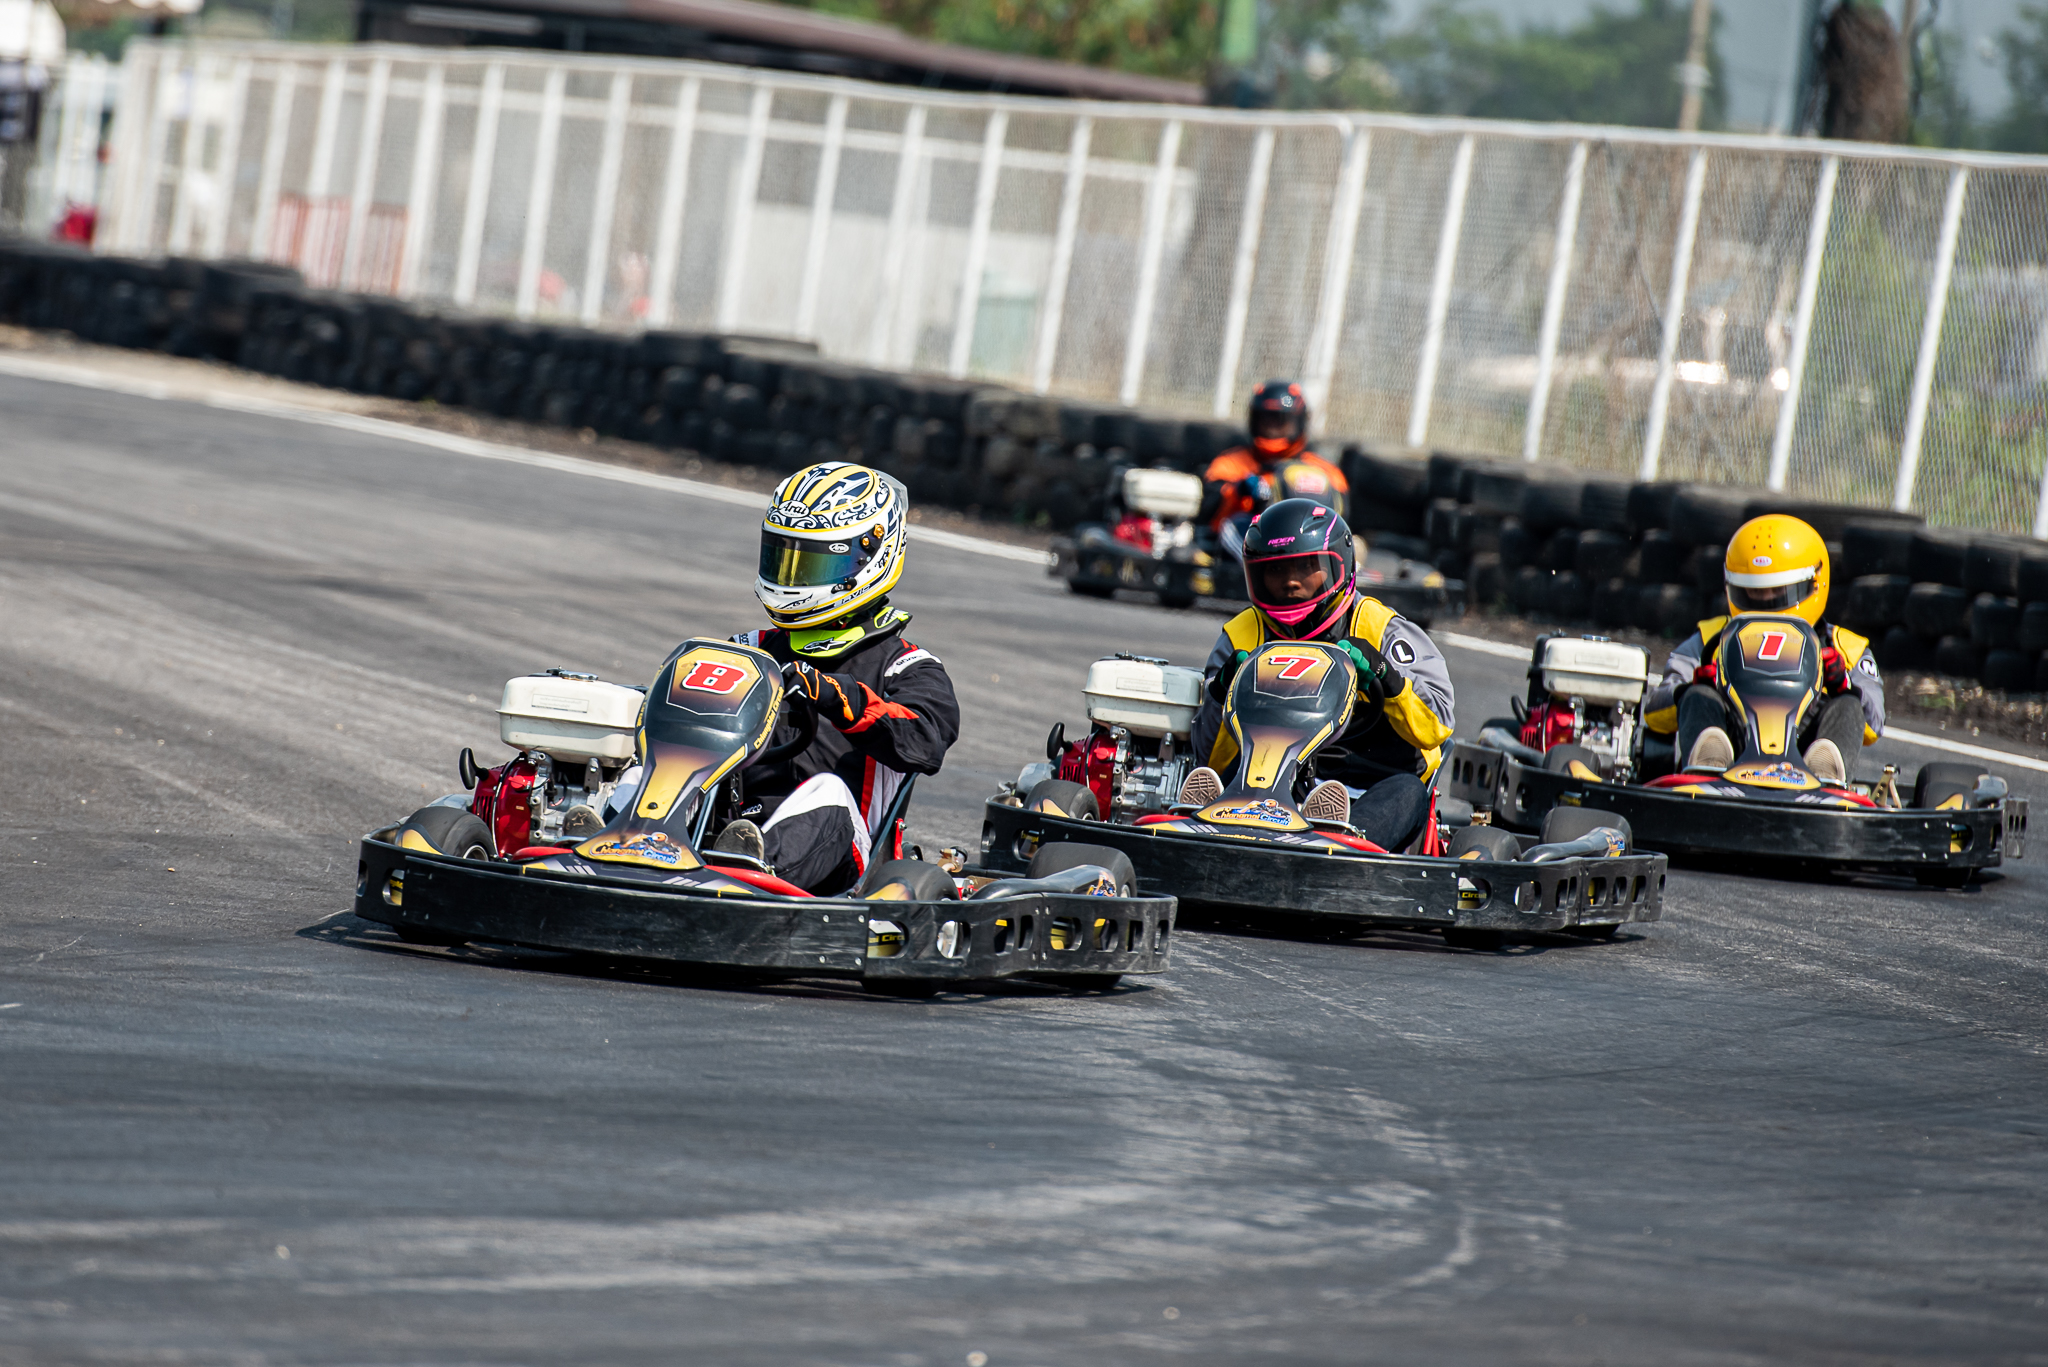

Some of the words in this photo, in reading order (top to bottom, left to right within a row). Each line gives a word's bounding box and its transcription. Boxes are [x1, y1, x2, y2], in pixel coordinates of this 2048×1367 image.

[779, 500, 807, 515] Arai
[1268, 536, 1296, 545] RIDER
[1394, 644, 1413, 662] L
[1757, 631, 1787, 660] 1
[1269, 655, 1320, 680] 7
[1861, 659, 1878, 677] M
[682, 660, 748, 694] 8
[1260, 814, 1290, 826] Circuit
[643, 849, 677, 864] Circuit
